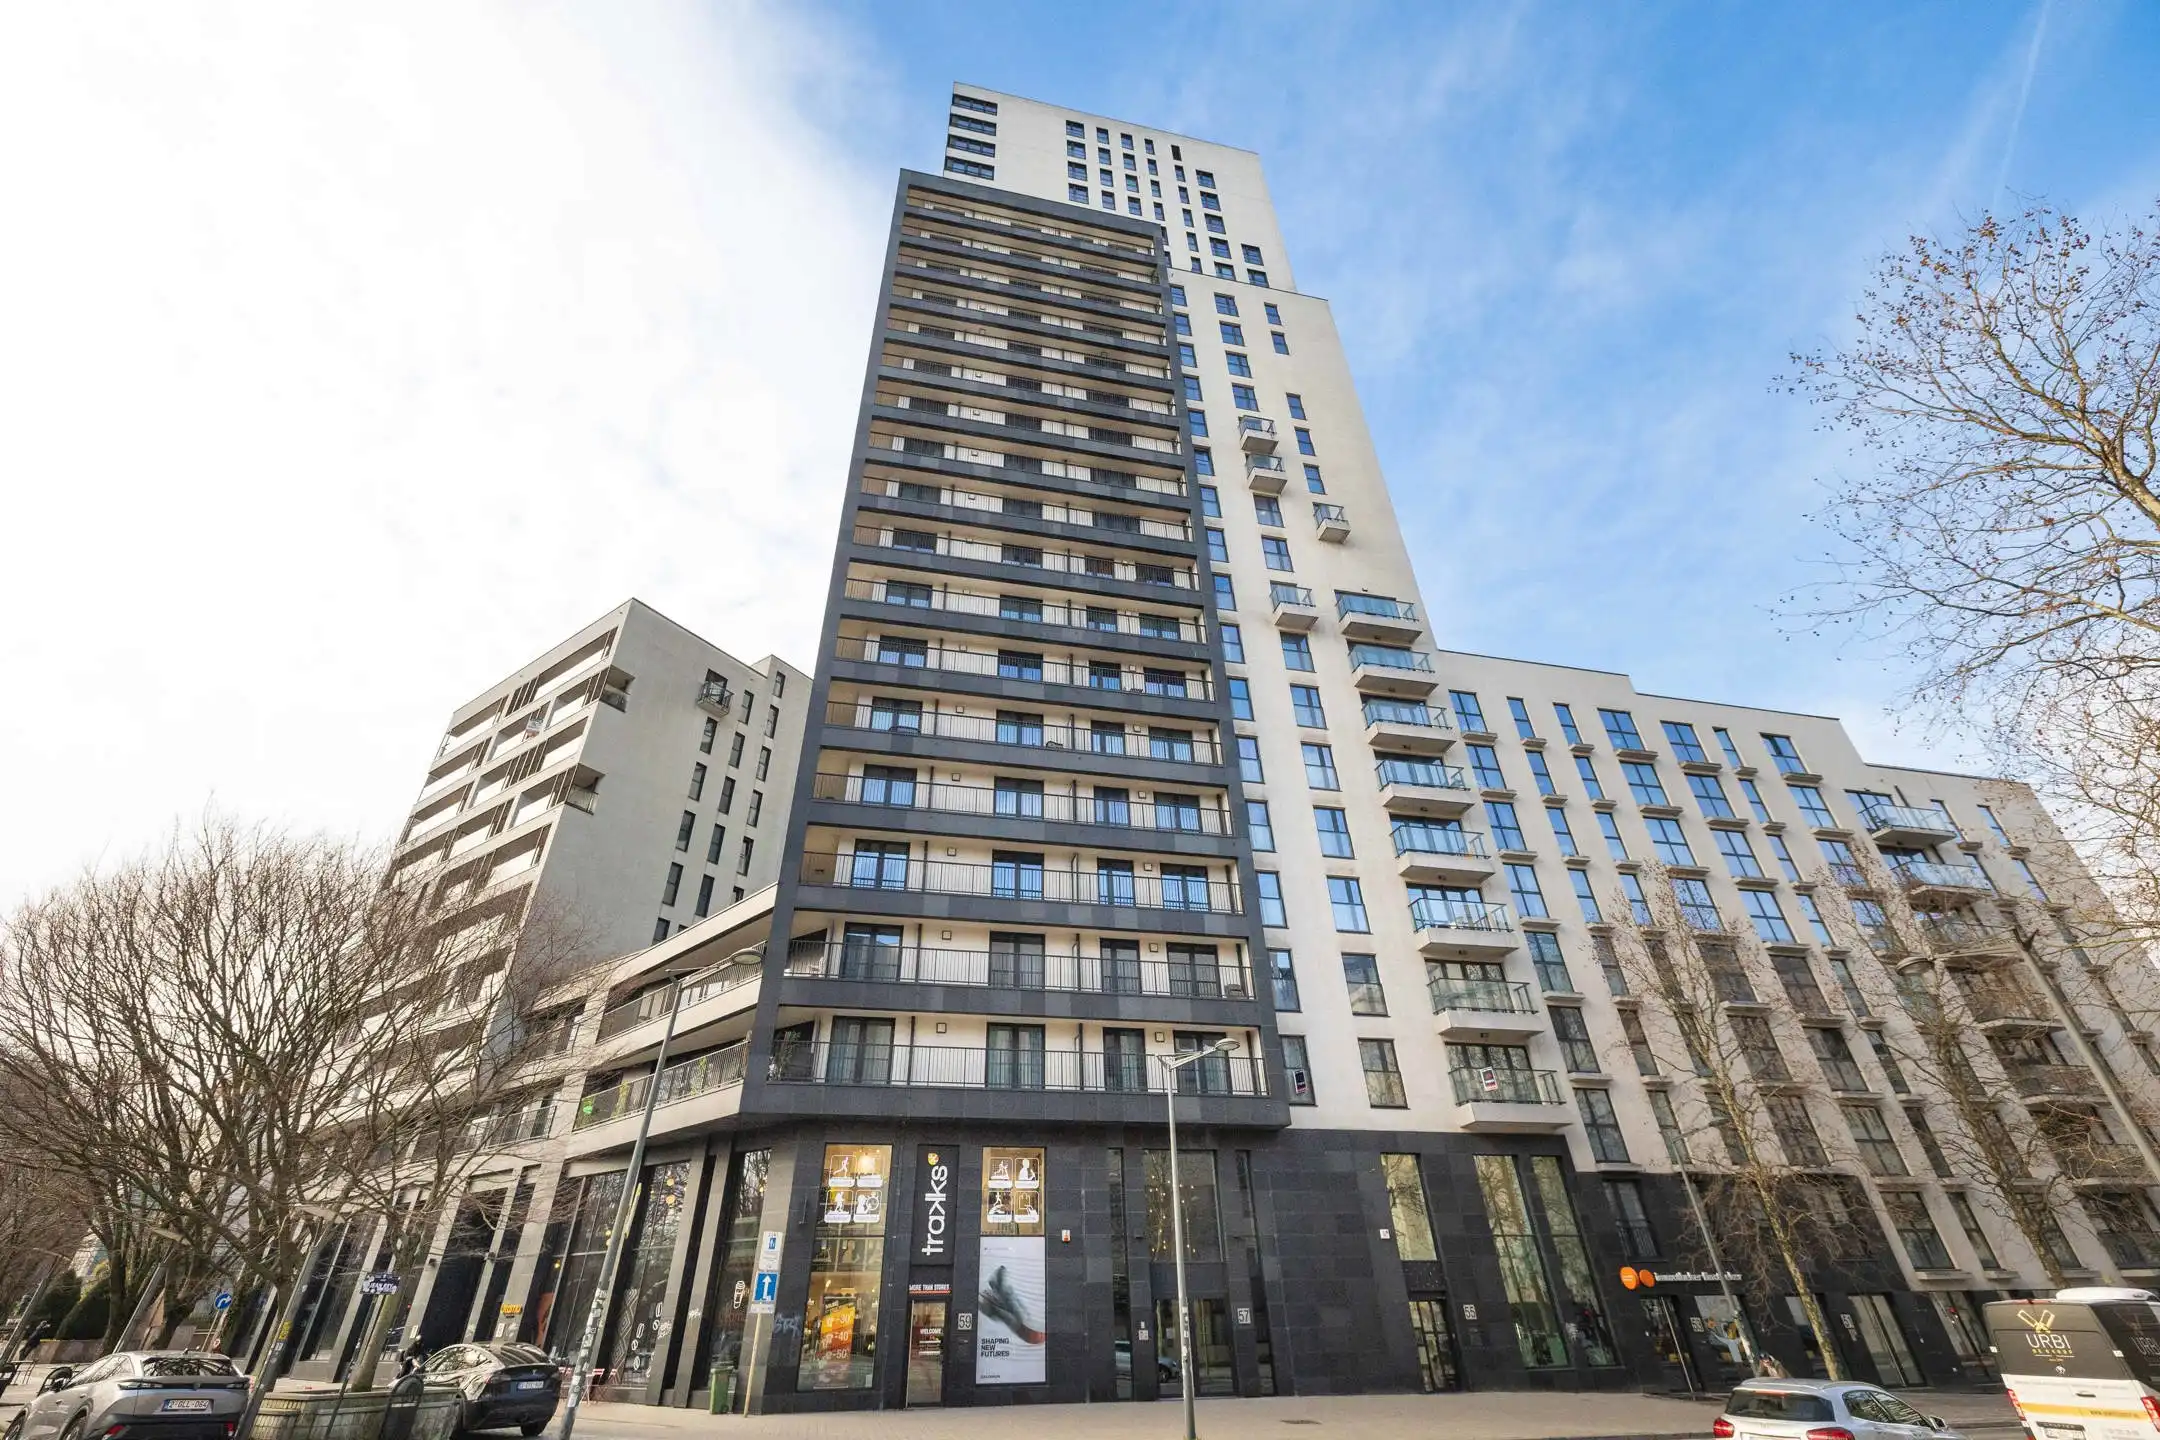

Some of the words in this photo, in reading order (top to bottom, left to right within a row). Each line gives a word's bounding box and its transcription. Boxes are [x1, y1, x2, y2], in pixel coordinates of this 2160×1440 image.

[1239, 1309, 1250, 1322] 57
[1464, 1306, 1476, 1319] 55
[959, 1315, 972, 1328] 59
[2025, 1333, 2072, 1349] URBI
